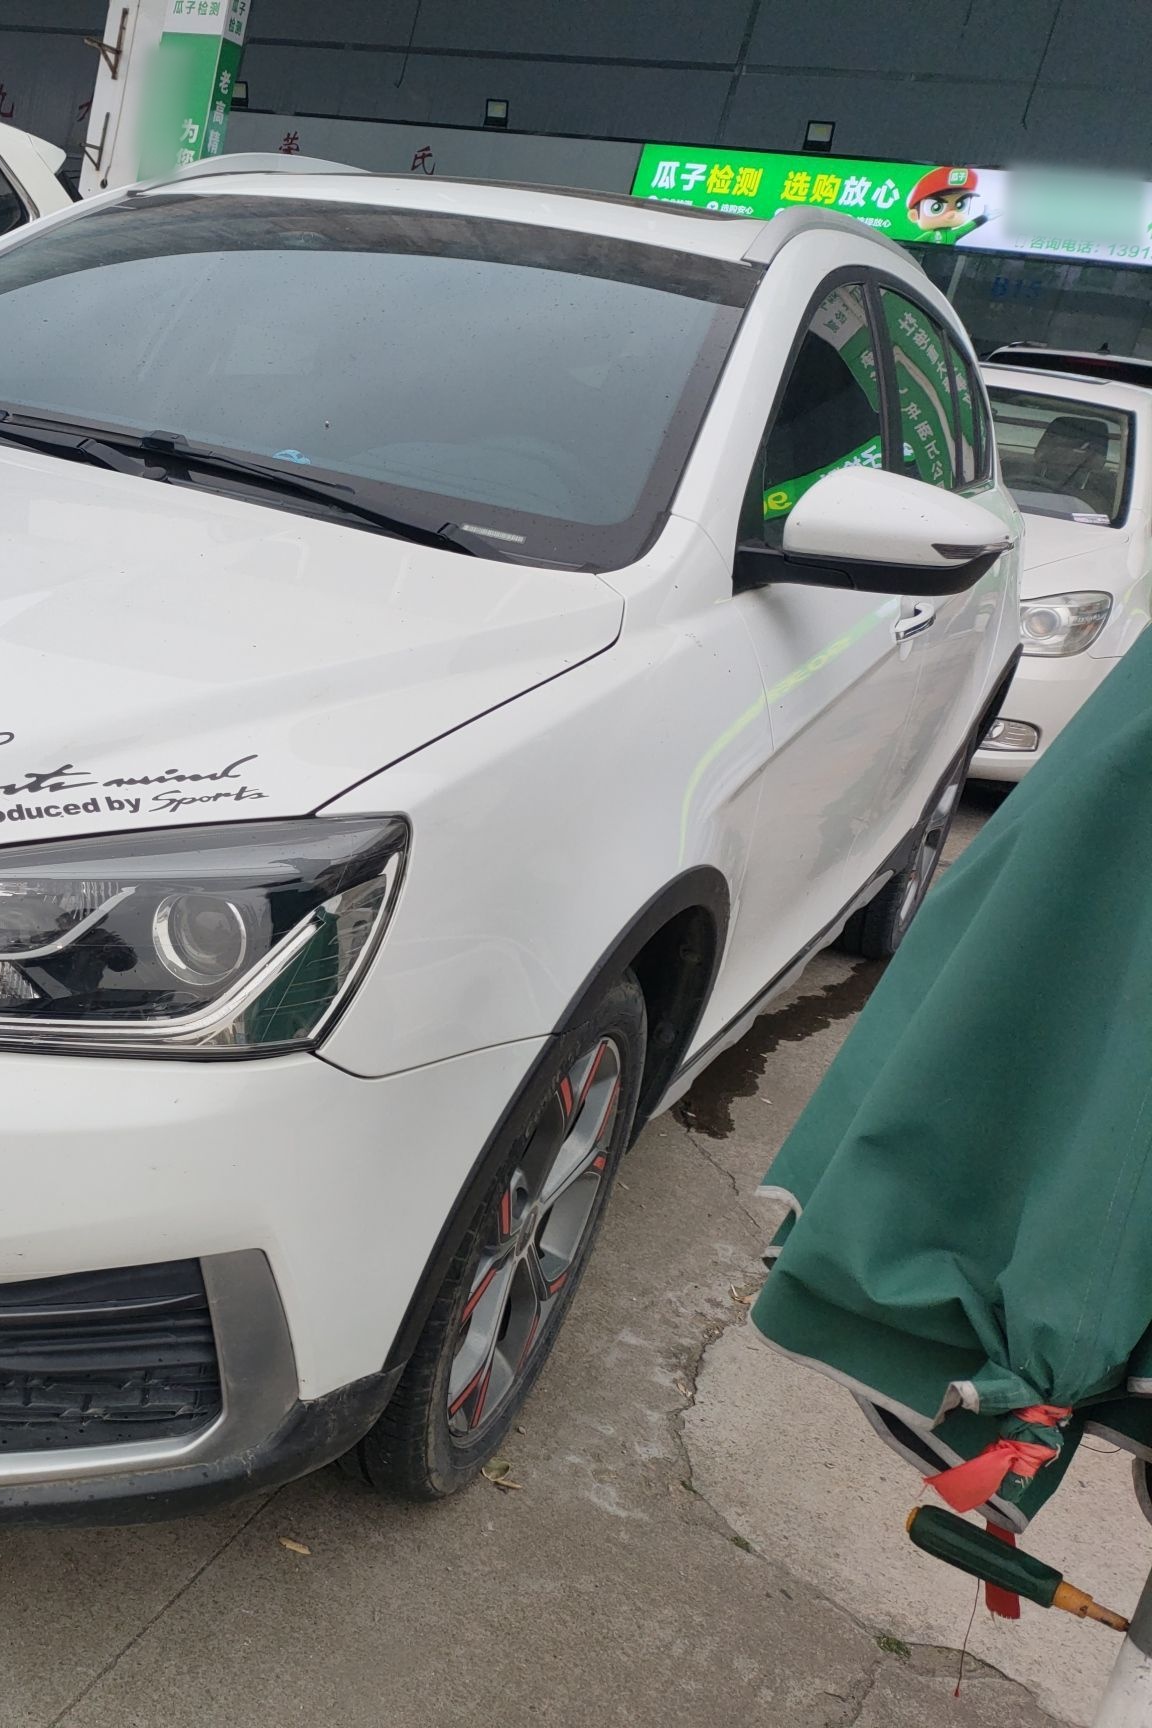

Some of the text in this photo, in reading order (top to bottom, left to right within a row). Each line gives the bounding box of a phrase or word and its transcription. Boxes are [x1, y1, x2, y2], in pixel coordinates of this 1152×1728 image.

[173, 0, 221, 16] 瓜子检测
[651, 160, 900, 209] 瓜子检测 选购放心
[107, 796, 141, 814] by
